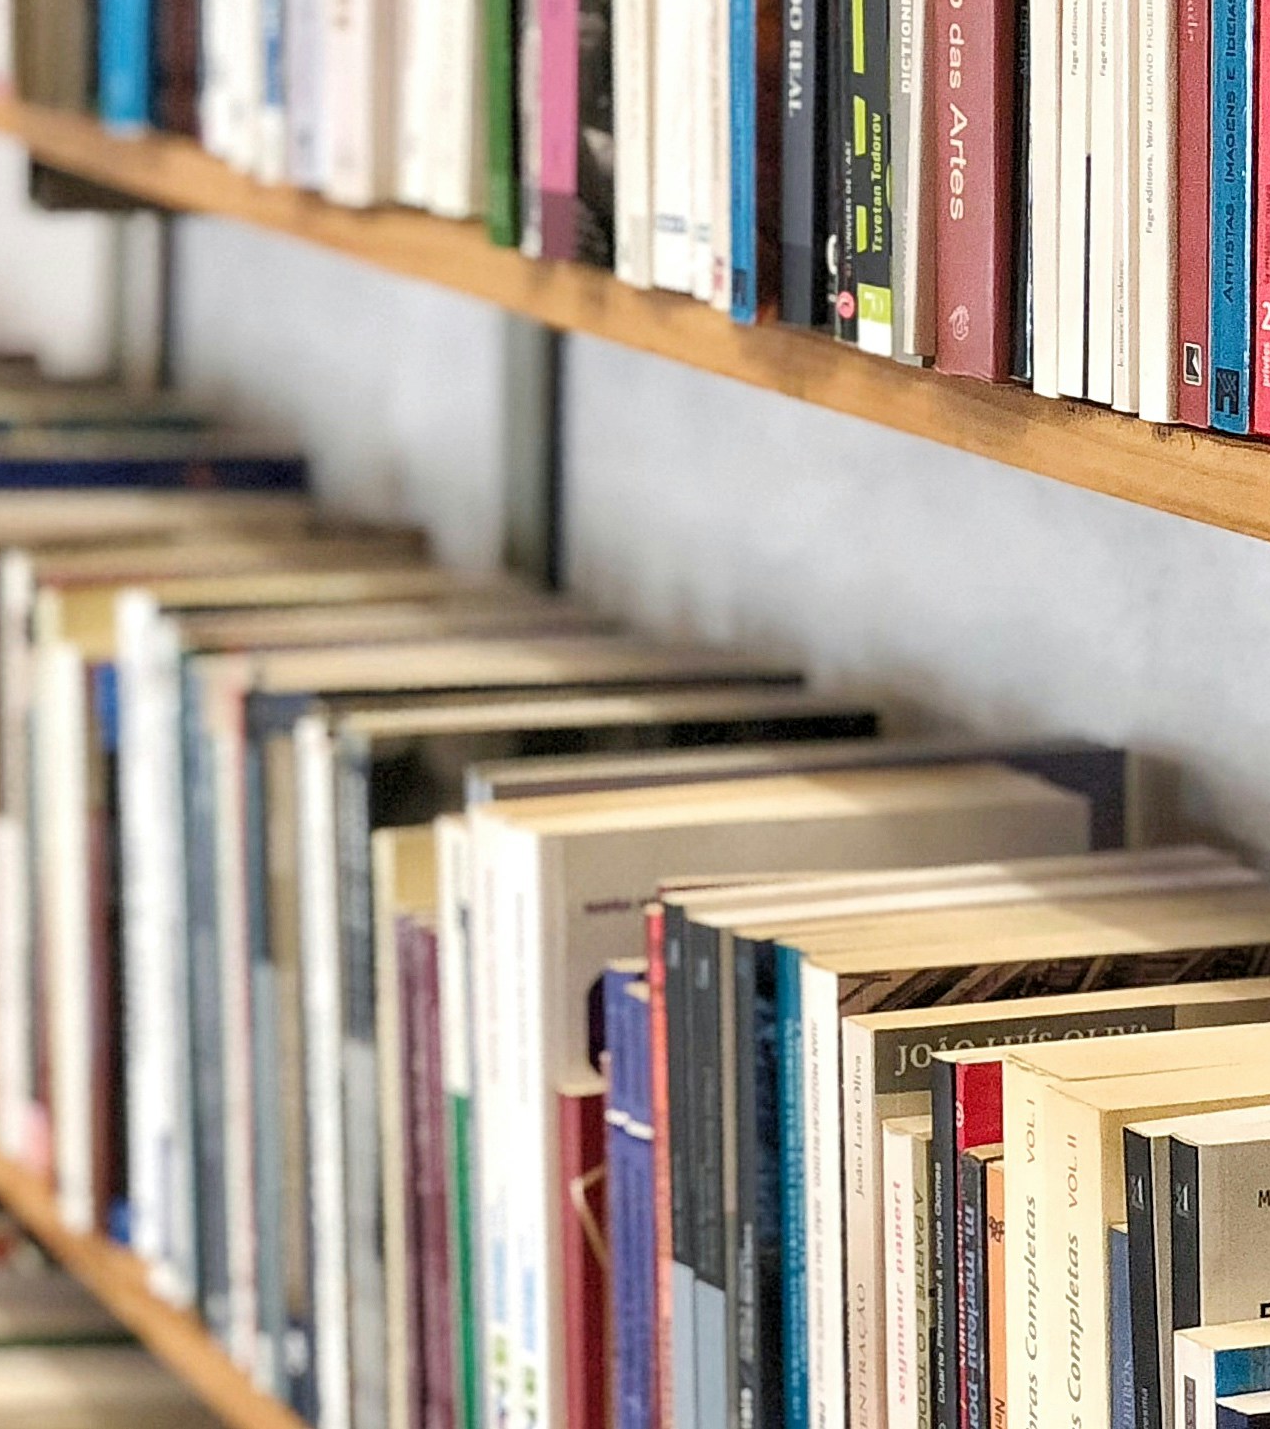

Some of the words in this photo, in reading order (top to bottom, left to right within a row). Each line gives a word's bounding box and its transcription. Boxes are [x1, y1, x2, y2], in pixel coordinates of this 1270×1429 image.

[788, 39, 802, 118] REAL
[948, 22, 965, 89] das
[1071, 50, 1080, 77] Fage
[1145, 53, 1154, 113] LUCIANO
[871, 112, 883, 181] Todorov
[1146, 120, 1154, 149] Varia
[948, 102, 968, 220] Artes
[871, 186, 883, 253] Tzvetan
[1145, 208, 1155, 234] Fage
[852, 1054, 862, 1106] Oliva
[1026, 1112, 1036, 1164] VOL.
[1066, 1133, 1078, 1148] II
[854, 1156, 865, 1197] João
[1067, 1157, 1078, 1209] VOL.
[893, 1181, 904, 1274] papert
[935, 1220, 944, 1265] Jorge
[914, 1214, 926, 1301] PARTE
[1023, 1194, 1040, 1361] Completas
[915, 1307, 926, 1323] E
[1064, 1232, 1084, 1403] Completas
[897, 1281, 907, 1405] seymour
[916, 1332, 926, 1353] O
[936, 1352, 946, 1403] Duarte
